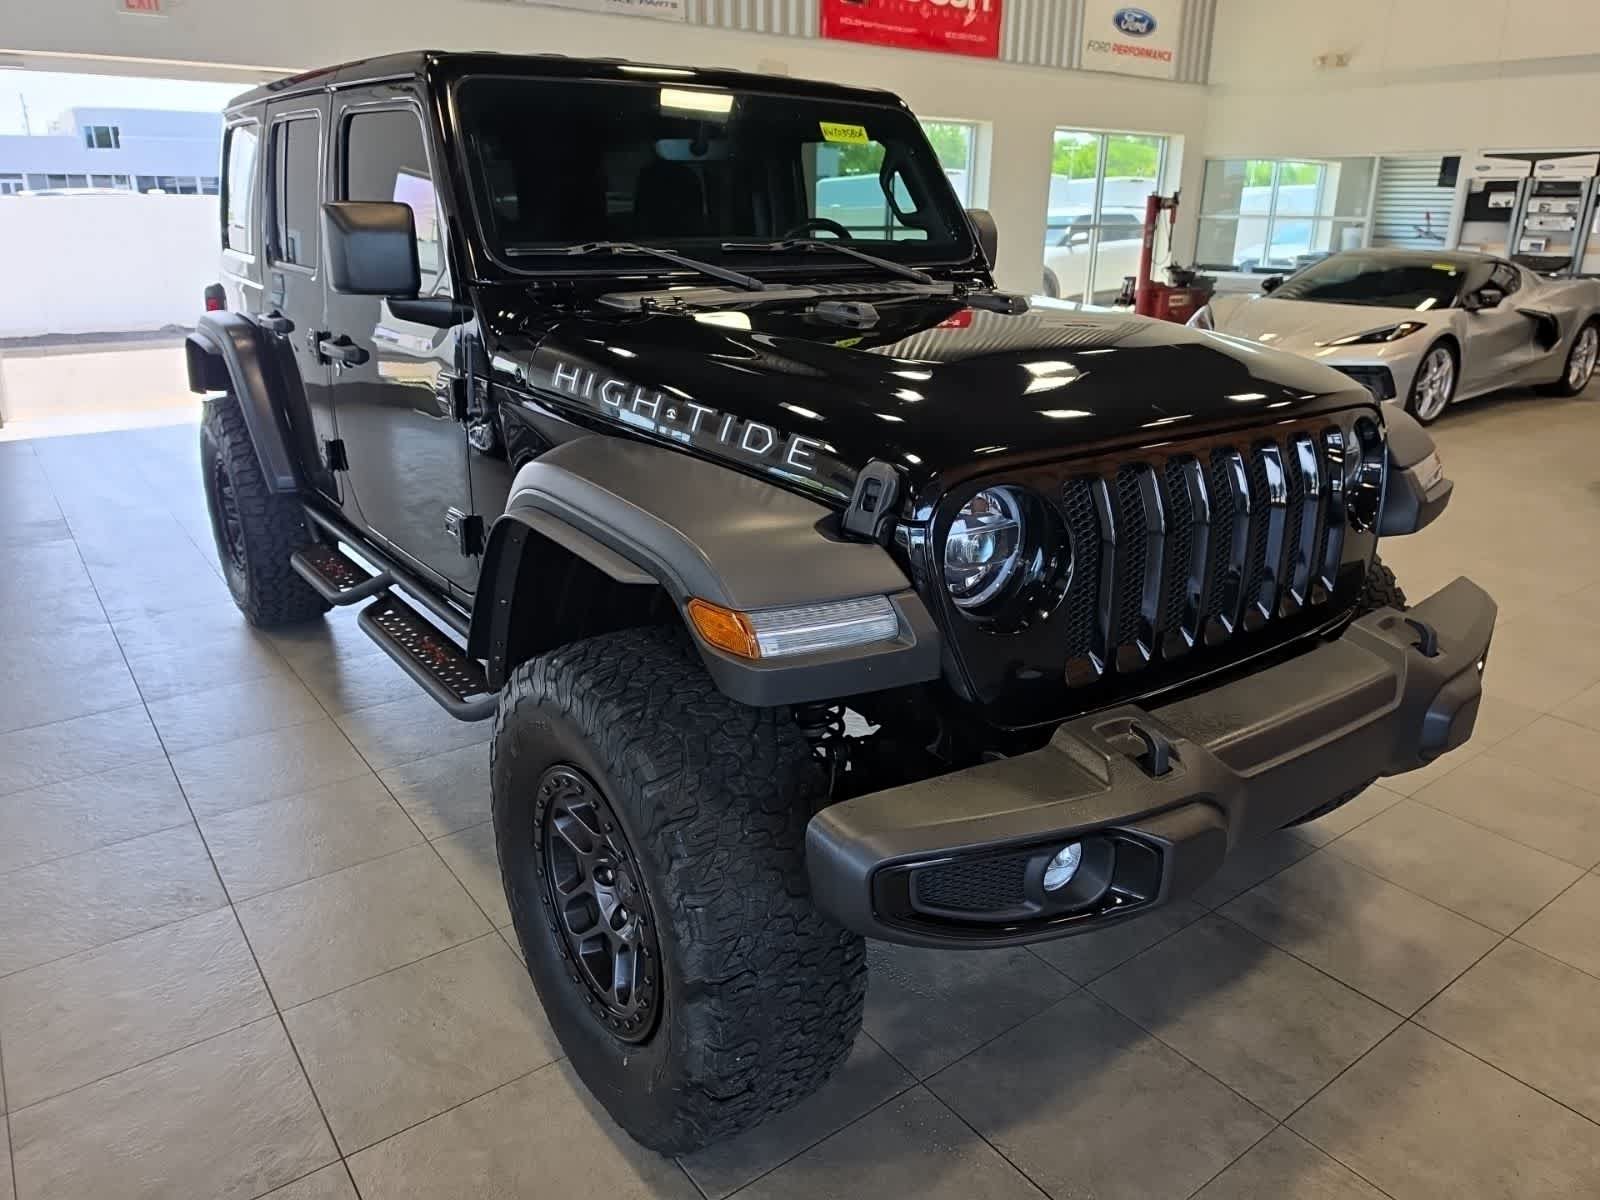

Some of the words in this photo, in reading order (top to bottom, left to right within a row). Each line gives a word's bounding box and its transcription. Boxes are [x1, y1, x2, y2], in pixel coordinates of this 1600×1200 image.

[1120, 11, 1150, 33] Ford
[1087, 40, 1111, 53] FORD
[1112, 42, 1173, 62] PERFORMANCE
[553, 363, 661, 419] HIGH
[687, 402, 823, 471] TIDE
